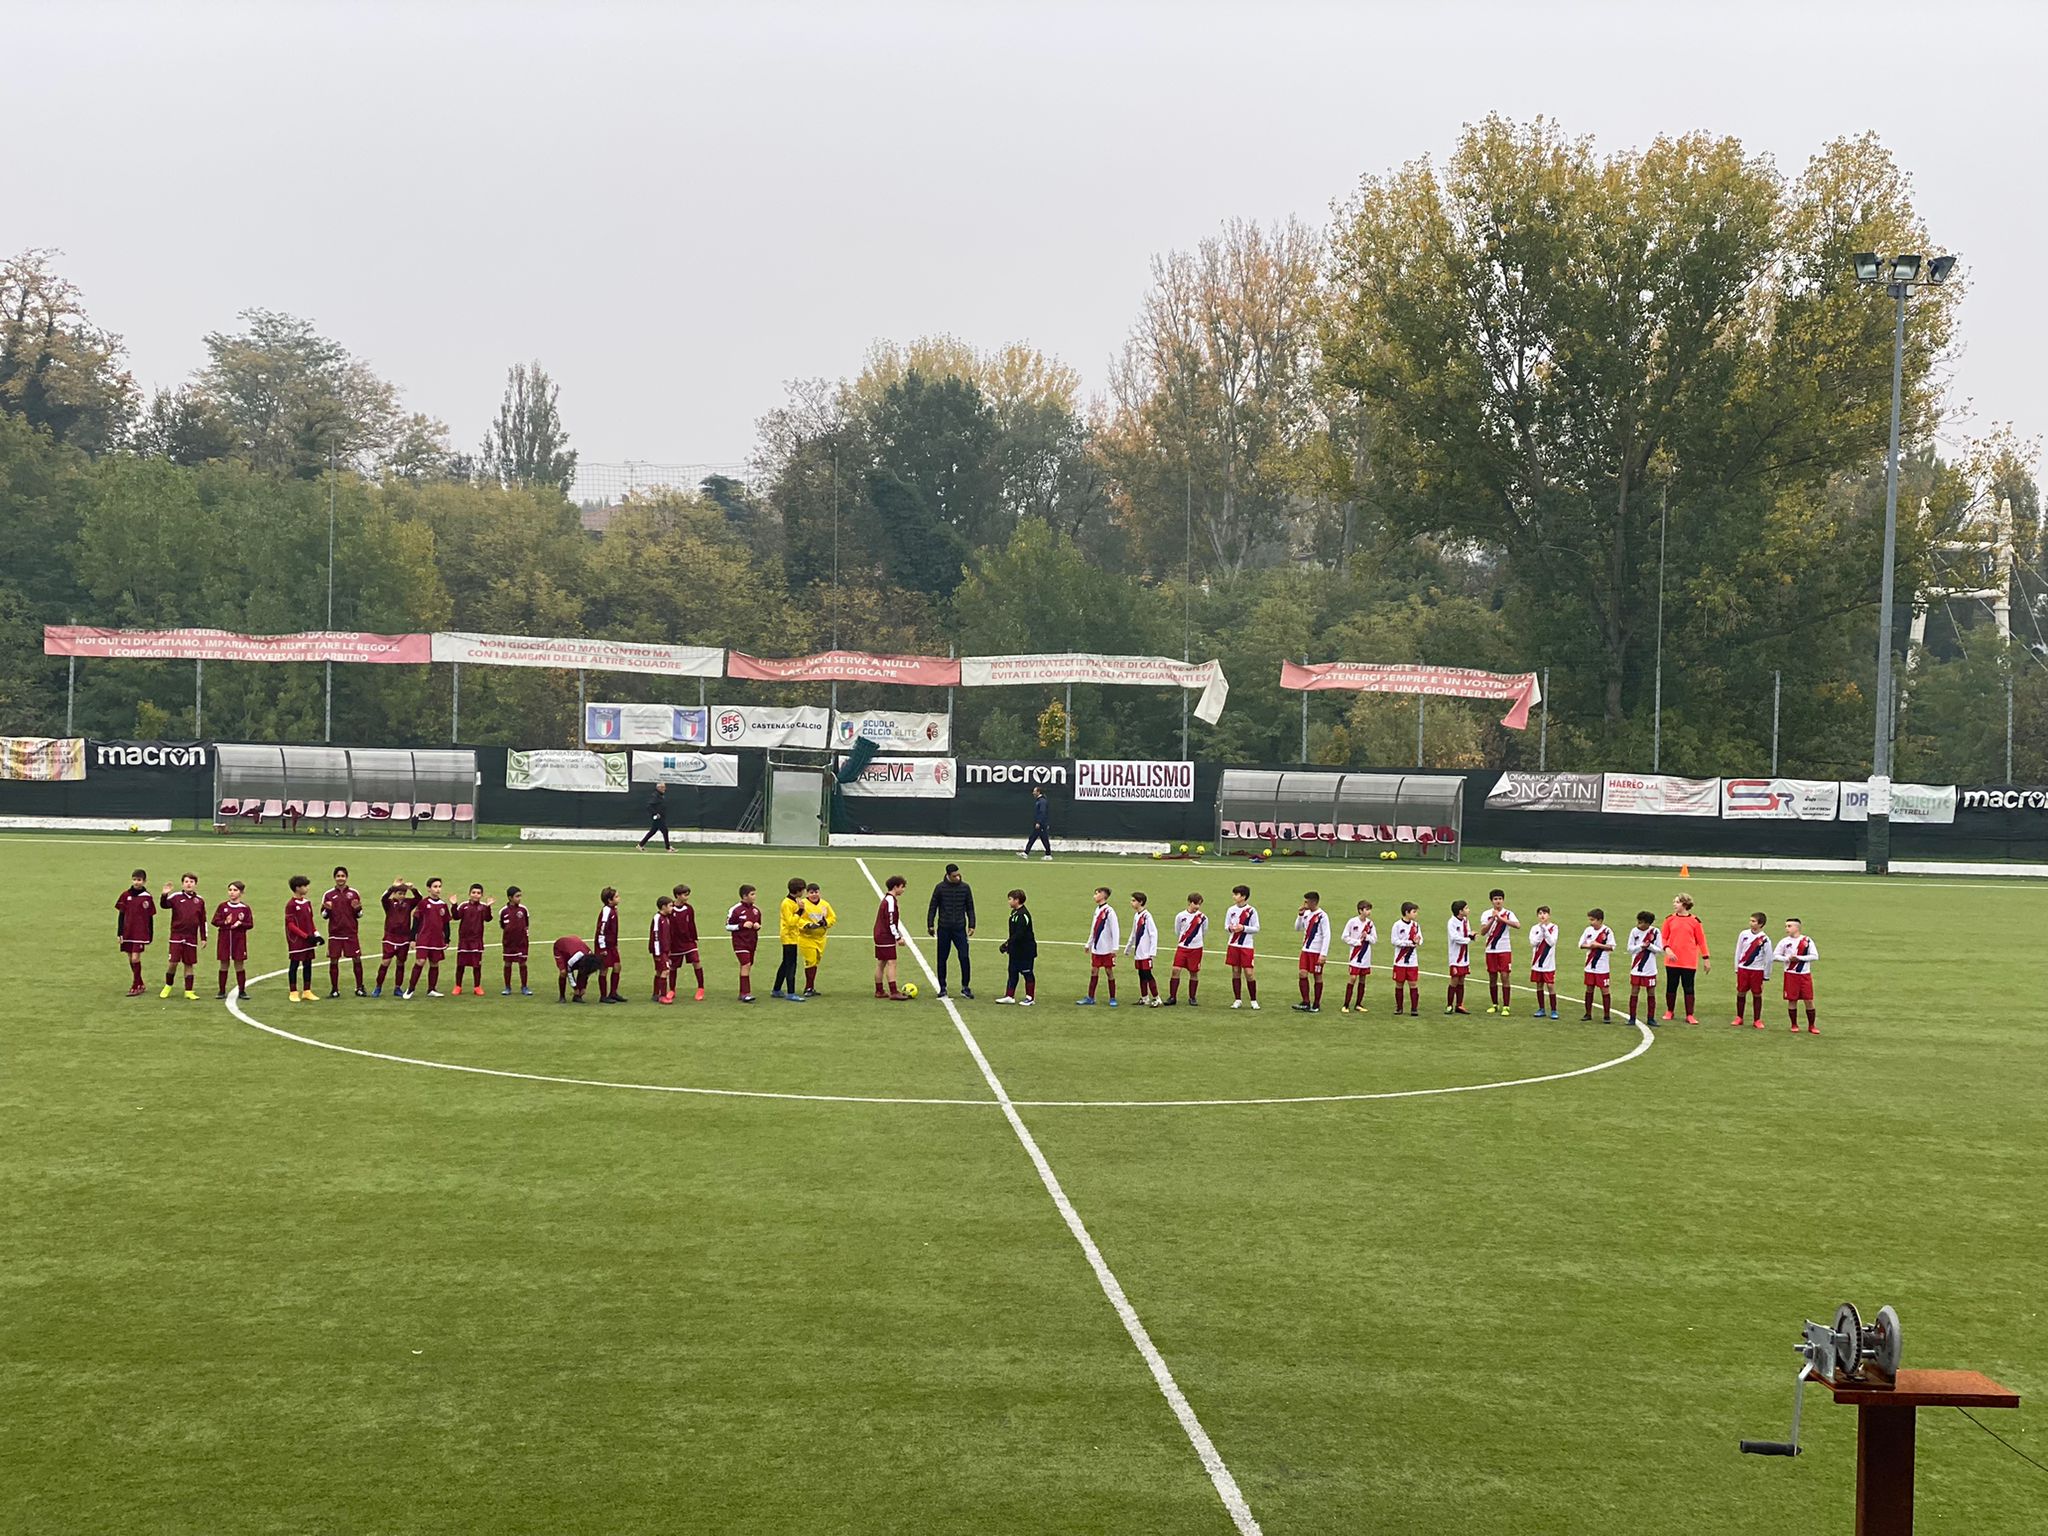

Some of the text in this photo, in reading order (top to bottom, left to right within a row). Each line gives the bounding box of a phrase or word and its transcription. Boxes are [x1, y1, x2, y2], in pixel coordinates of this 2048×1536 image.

[193, 629, 236, 638] QUESTO
[325, 630, 359, 640] GIOCO
[76, 637, 95, 645] NOI
[98, 637, 118, 646] QUI
[120, 638, 131, 646] CI
[205, 639, 267, 650] IMPARIAMO
[270, 641, 278, 650] A
[280, 641, 340, 650] RISPETTARE
[343, 642, 355, 650] LE
[480, 640, 671, 658] NON GIOCHIAMO MAI CONTRO MA
[226, 650, 243, 660] GLI
[244, 651, 304, 661] AVVERSARI
[467, 649, 492, 658] CON
[501, 651, 551, 661] BAMBINI
[553, 654, 587, 664] DELLE
[590, 656, 625, 666] ALTRE
[627, 659, 681, 669] SQUADRE
[805, 656, 832, 666] NON
[833, 655, 868, 666] SERVE
[871, 658, 880, 667] A
[882, 659, 920, 669] NULLA
[991, 661, 1012, 669] NON
[1015, 659, 1073, 669] ROVINATECI
[1075, 659, 1084, 667] IL
[1087, 659, 1125, 669] PIACERE
[1127, 661, 1138, 669] DI
[781, 666, 897, 678] LASCIATECI GIOCARE
[992, 671, 1031, 680] EVITATE
[1040, 669, 1089, 678] COMMENTI
[1100, 670, 1115, 678] GLI
[1117, 671, 1193, 682] ATTEGGIAMENTI
[1438, 666, 1487, 678] NOSTRO
[1382, 673, 1428, 684] SEMPRE
[1443, 677, 1460, 686] UN
[1464, 679, 1511, 689] VOSTRO
[1395, 684, 1421, 693] UNA
[1423, 685, 1457, 696] GIOIA
[1460, 688, 1482, 698] PER
[1485, 690, 1507, 699] NOI
[721, 715, 740, 725] BFC
[796, 722, 822, 730] CALCIO
[863, 719, 895, 728] SCUOLA
[722, 723, 740, 734] 365
[862, 728, 892, 736] CALCIO
[97, 746, 206, 766] macron
[508, 772, 530, 784] MZ
[859, 763, 914, 782] ARISMA
[966, 764, 1067, 784] macron
[1079, 764, 1190, 787] PLURALISMO
[605, 775, 627, 787] MZ
[1079, 787, 1190, 799] WWW.CASTENASOCALCIO.COM
[1506, 781, 1597, 799] ONCATINI
[1845, 792, 1869, 807] IDR
